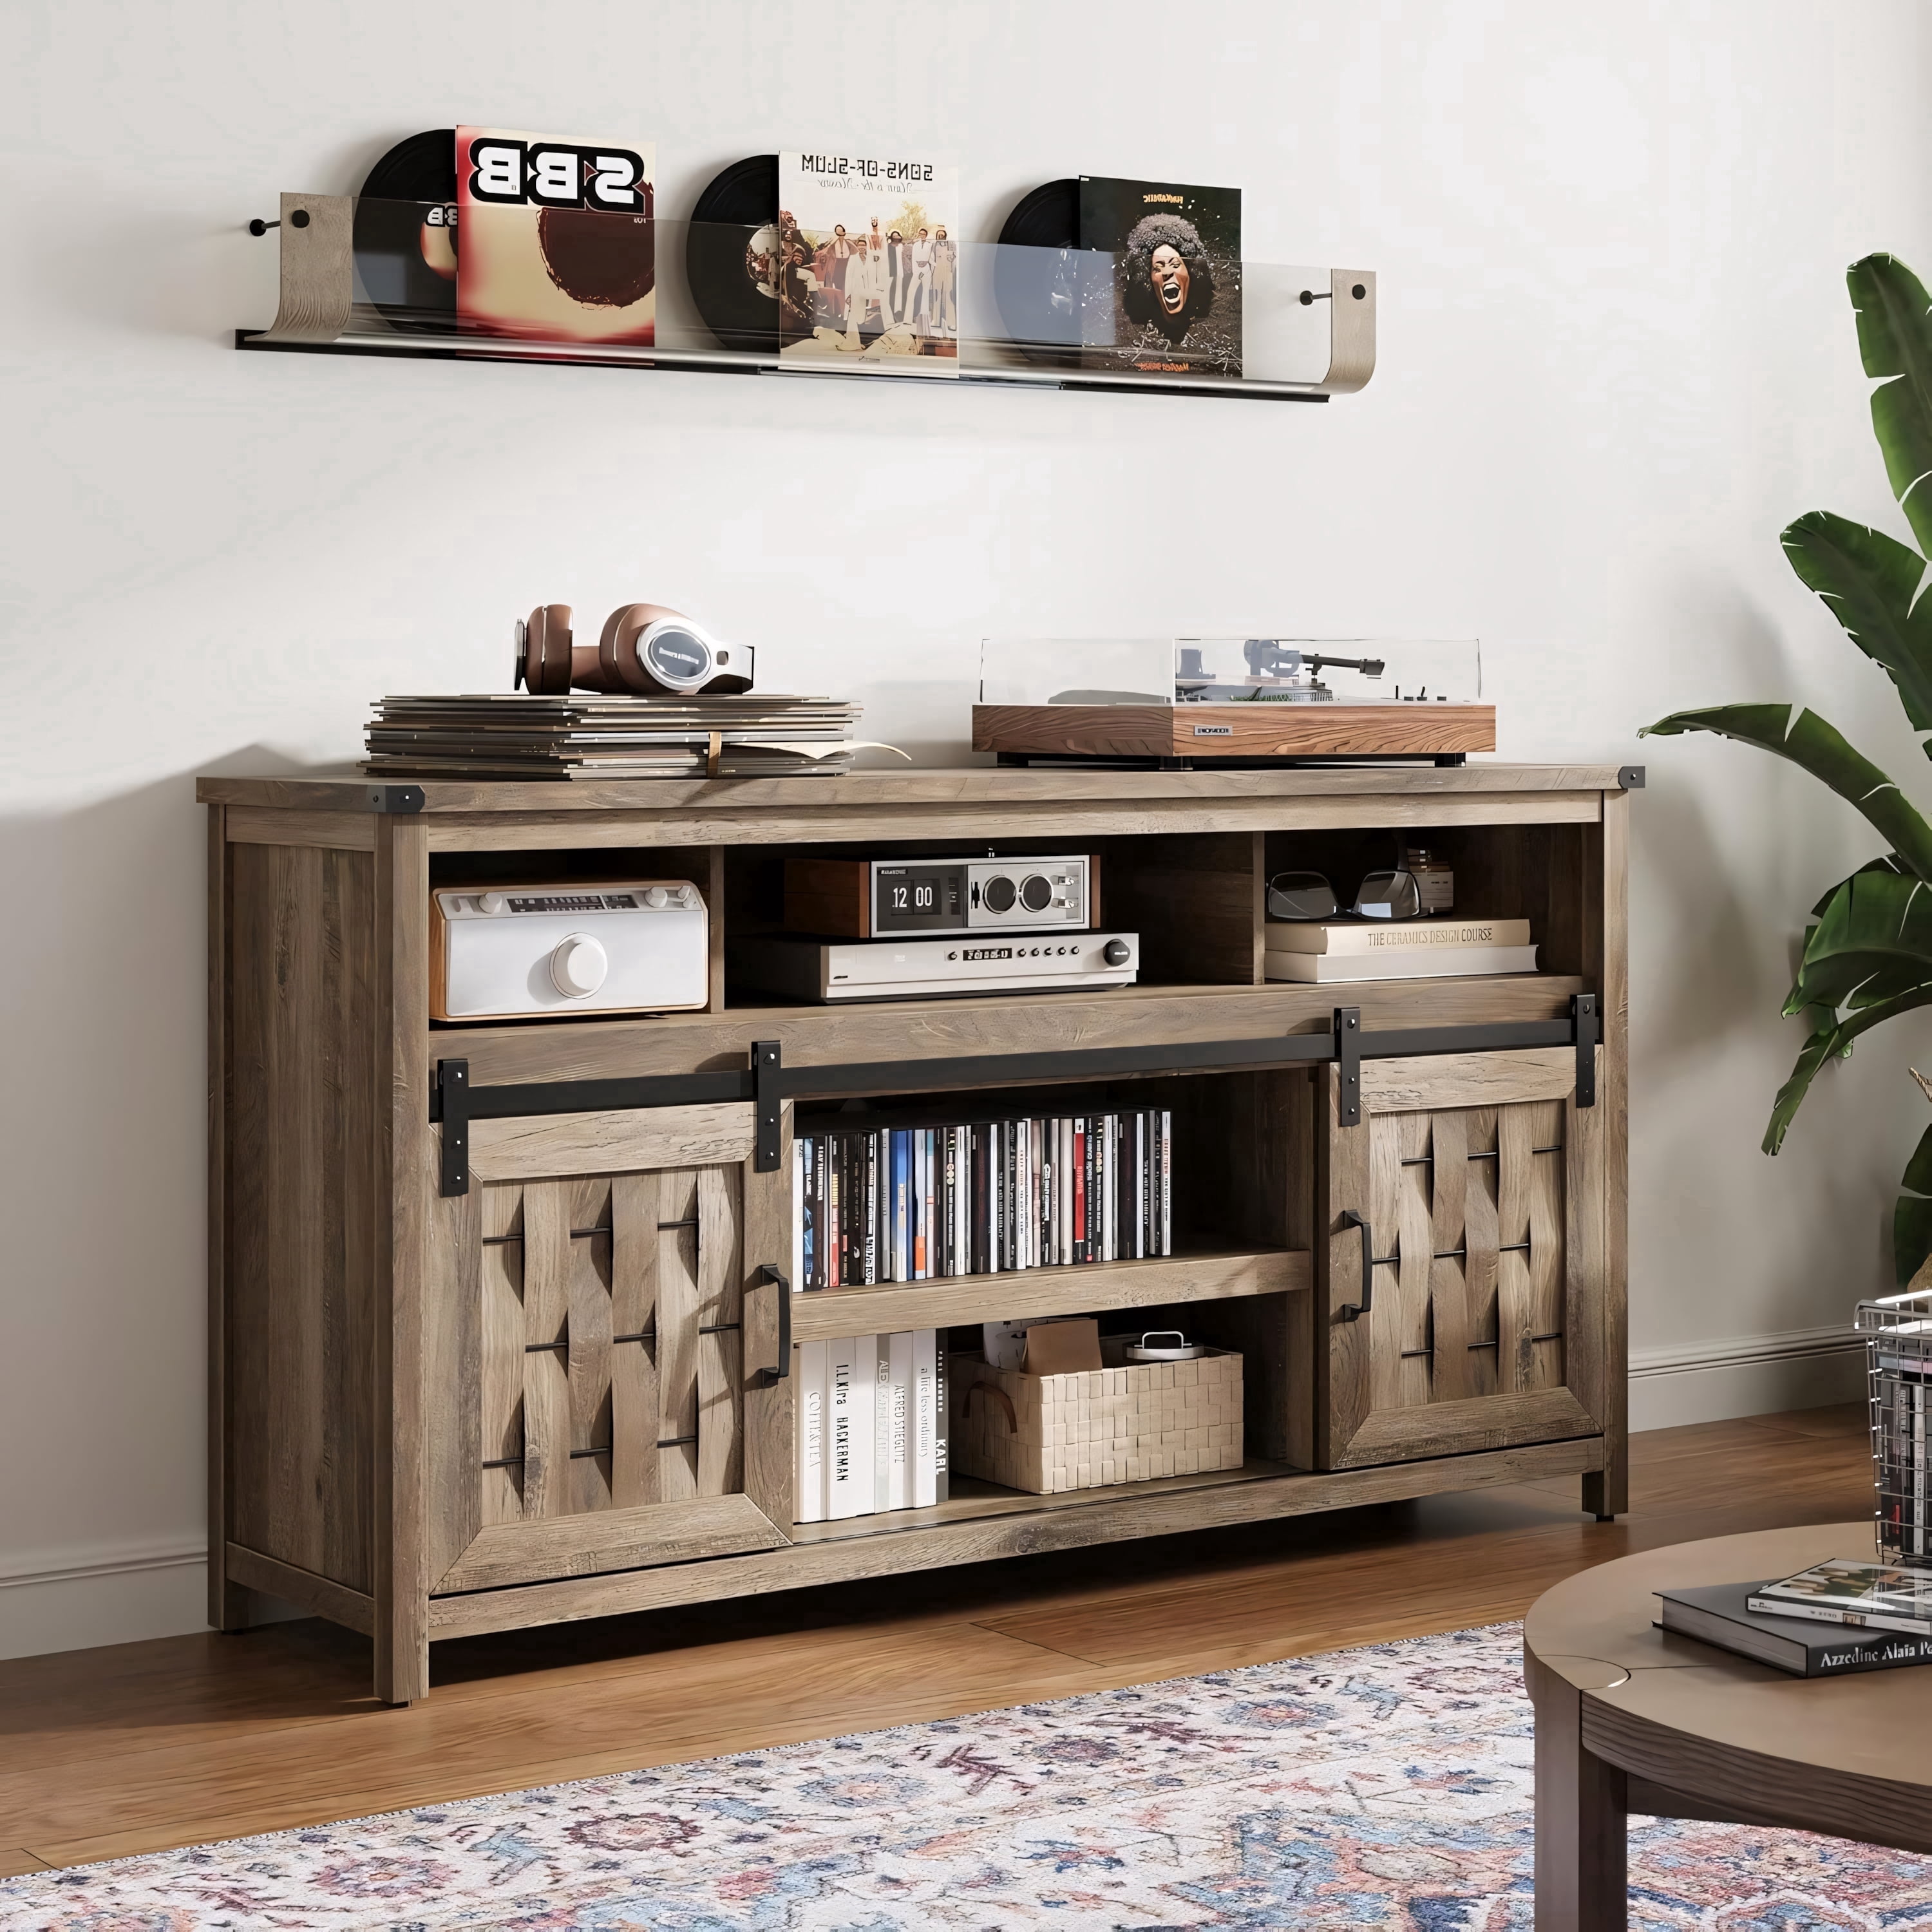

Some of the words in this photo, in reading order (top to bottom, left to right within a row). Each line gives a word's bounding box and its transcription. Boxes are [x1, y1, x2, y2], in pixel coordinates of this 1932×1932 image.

[893, 887, 907, 908] 12
[916, 886, 933, 907] 00
[1368, 933, 1385, 947] THE
[1430, 929, 1460, 944] DESIGN
[1461, 928, 1493, 943] COURSE
[894, 1385, 905, 1418] ALFRED
[837, 1416, 849, 1482] HACKERMAN
[894, 1420, 905, 1464] STIEGLITZ
[936, 1438, 947, 1475] KARL
[1820, 1647, 1879, 1668] Azzedine
